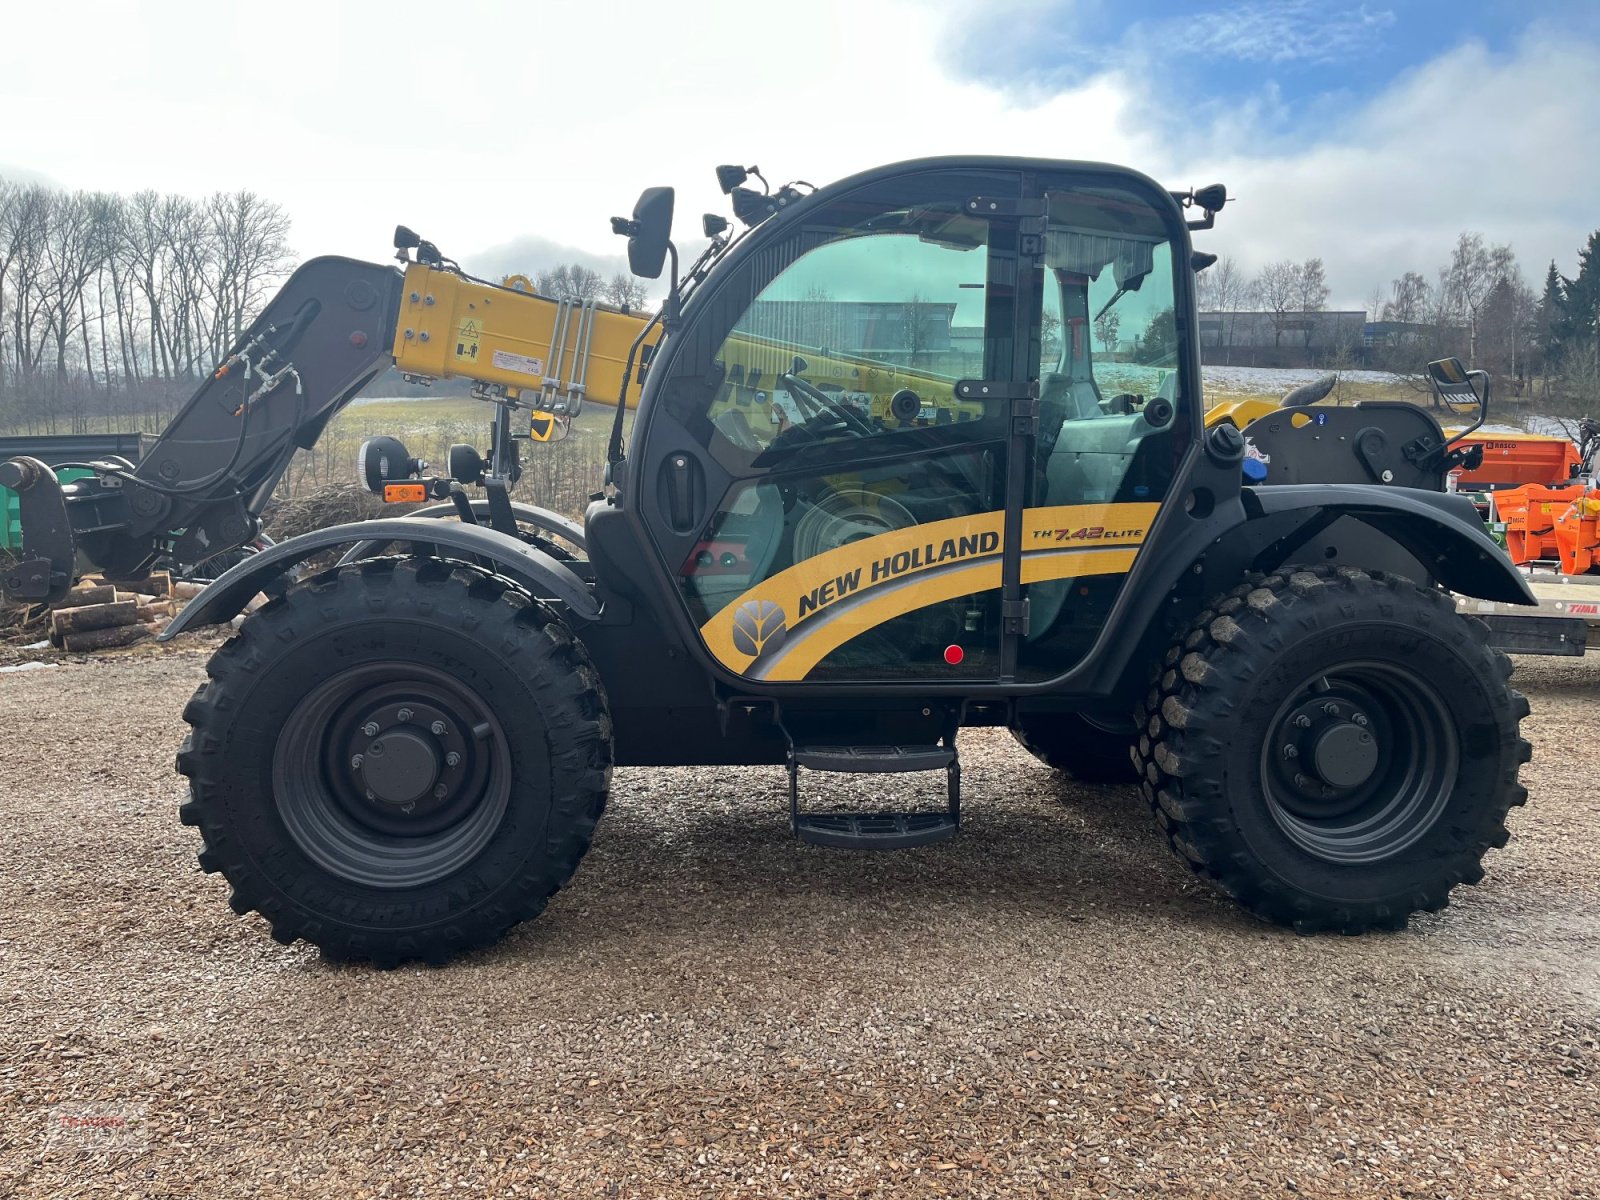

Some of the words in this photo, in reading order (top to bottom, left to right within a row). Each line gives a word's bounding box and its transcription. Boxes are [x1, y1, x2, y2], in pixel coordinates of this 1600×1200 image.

[1033, 530, 1053, 539] TH
[1054, 527, 1105, 541] 7.42
[1104, 530, 1142, 539] ELITE
[799, 568, 862, 618] NEW
[871, 531, 1000, 582] HOLLAND
